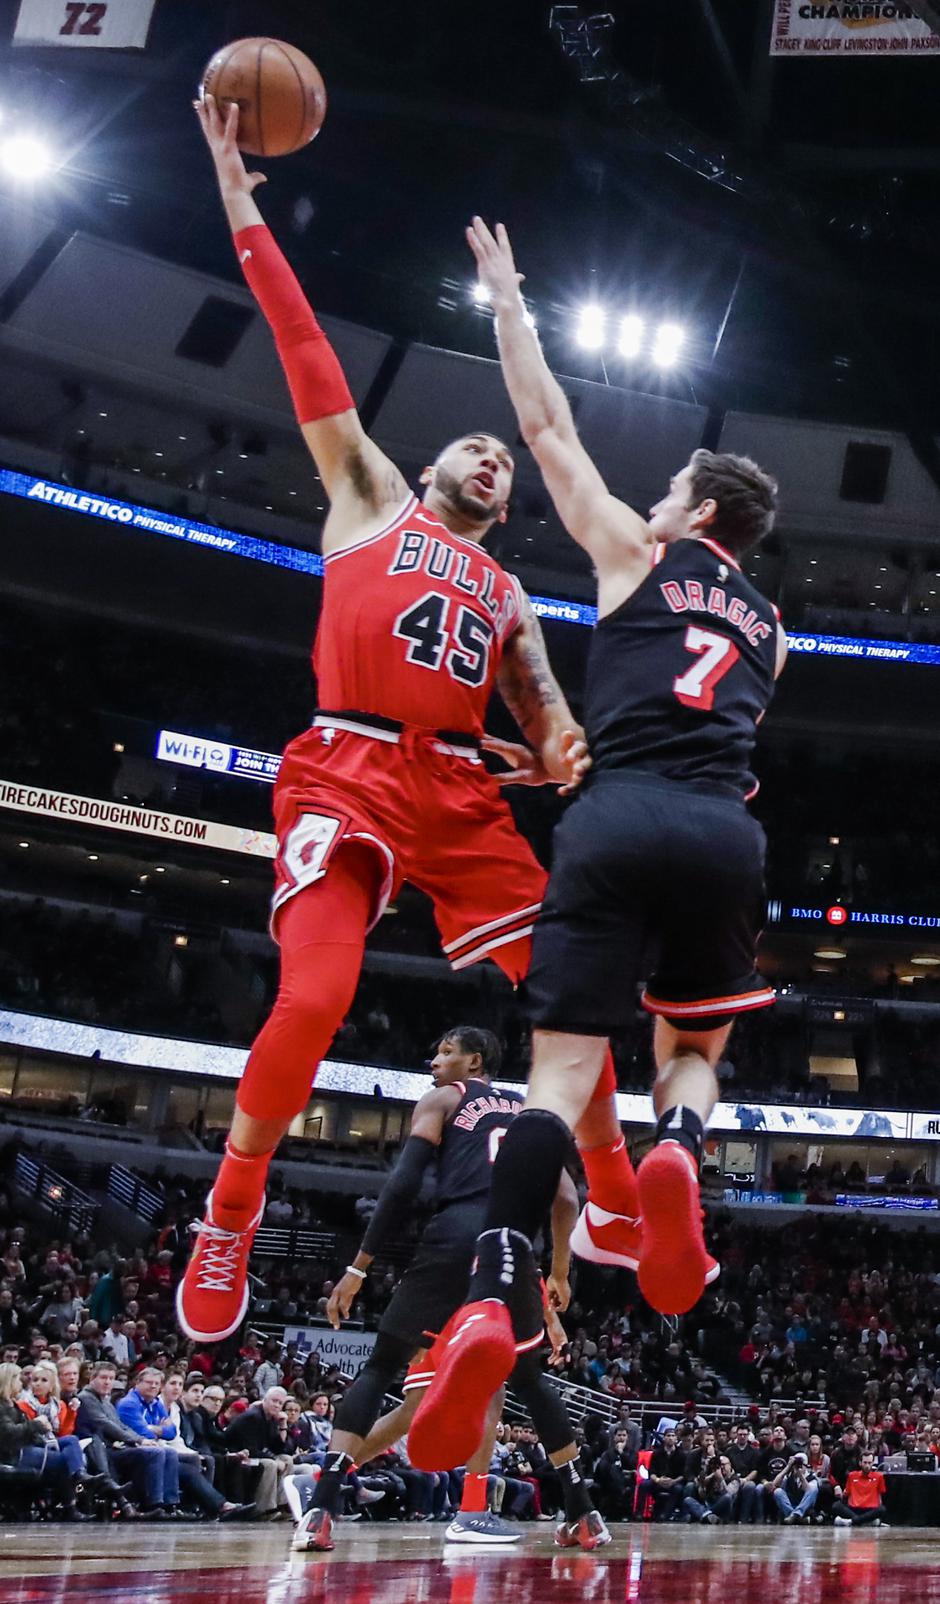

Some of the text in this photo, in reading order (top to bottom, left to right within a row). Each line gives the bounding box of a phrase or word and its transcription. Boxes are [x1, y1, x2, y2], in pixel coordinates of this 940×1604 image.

[59, 2, 108, 36] 72
[798, 5, 921, 20] CHAMPION
[775, 38, 800, 50] STACEY
[27, 481, 237, 550] ATHLETICO PHYSICAL THERAPY
[392, 591, 494, 688] 45
[817, 642, 864, 655] PHYSICAL
[865, 646, 911, 660] THERAPY
[672, 624, 741, 711] 7
[165, 738, 207, 761] WI-FI
[234, 756, 263, 771] JOIN
[0, 784, 208, 840] IRECAKESDOUGHNUTS.COM
[791, 907, 823, 919] BMO
[851, 911, 904, 925] HARRIS
[315, 1337, 375, 1356] Advocate
